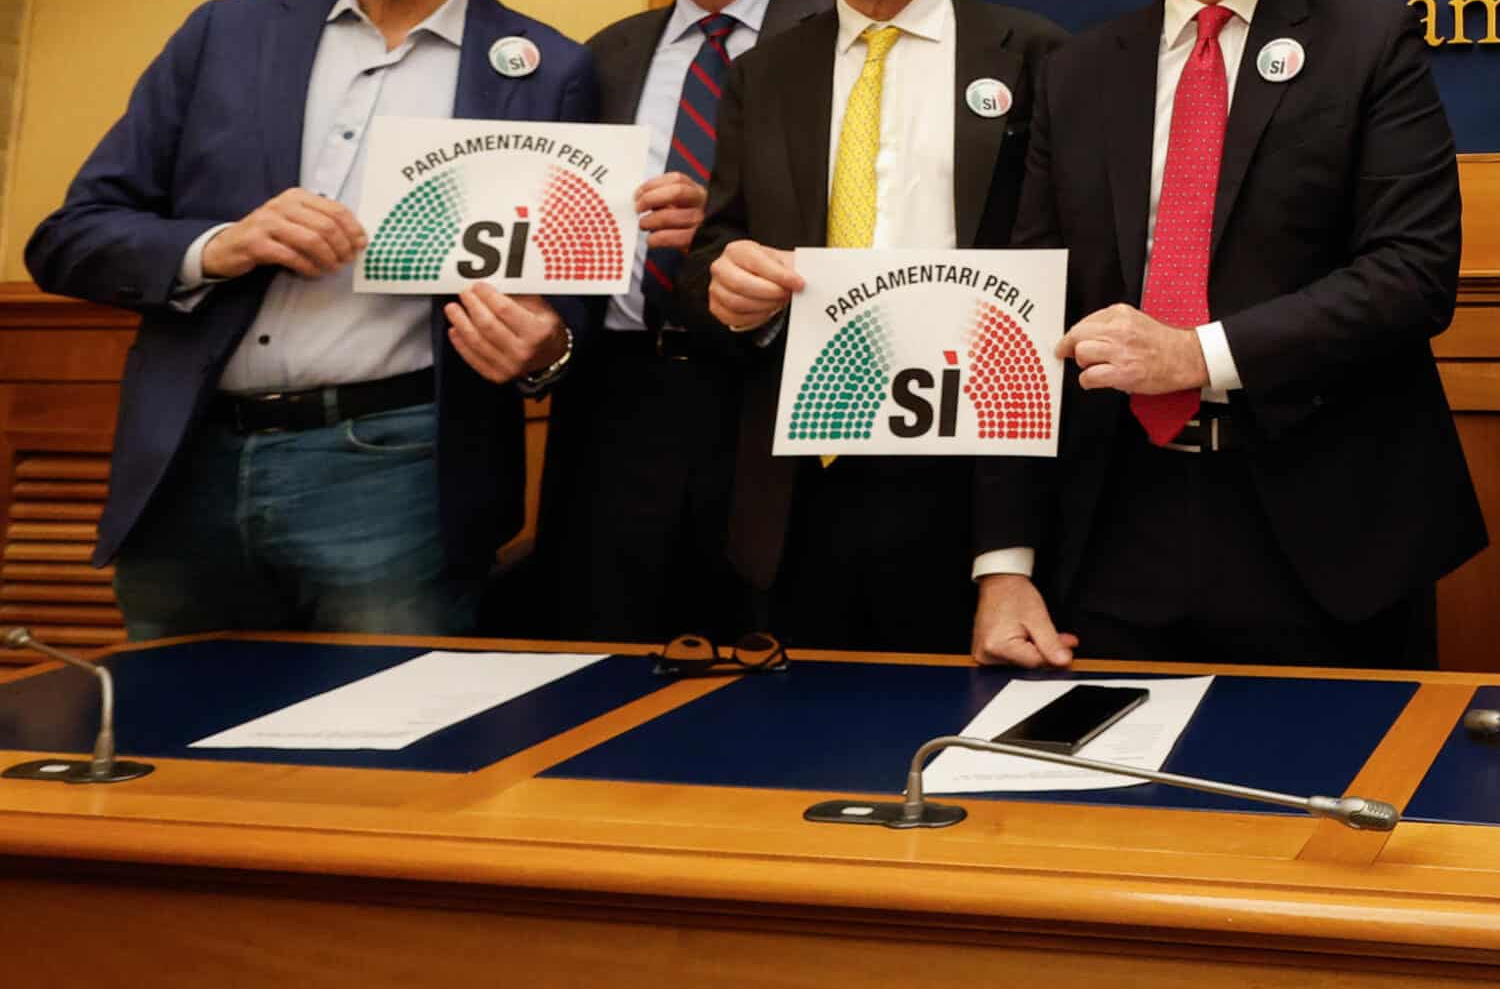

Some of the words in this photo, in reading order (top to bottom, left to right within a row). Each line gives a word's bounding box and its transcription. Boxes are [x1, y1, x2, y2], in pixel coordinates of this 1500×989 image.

[401, 134, 555, 182] PARLAMENTARI
[557, 143, 593, 171] PER
[591, 165, 611, 184] IL
[457, 206, 531, 280] SÌ
[825, 264, 980, 323] PARLAMENTARI
[982, 274, 1020, 307] PER
[1019, 298, 1036, 323] IL
[888, 350, 961, 439] SÌ
